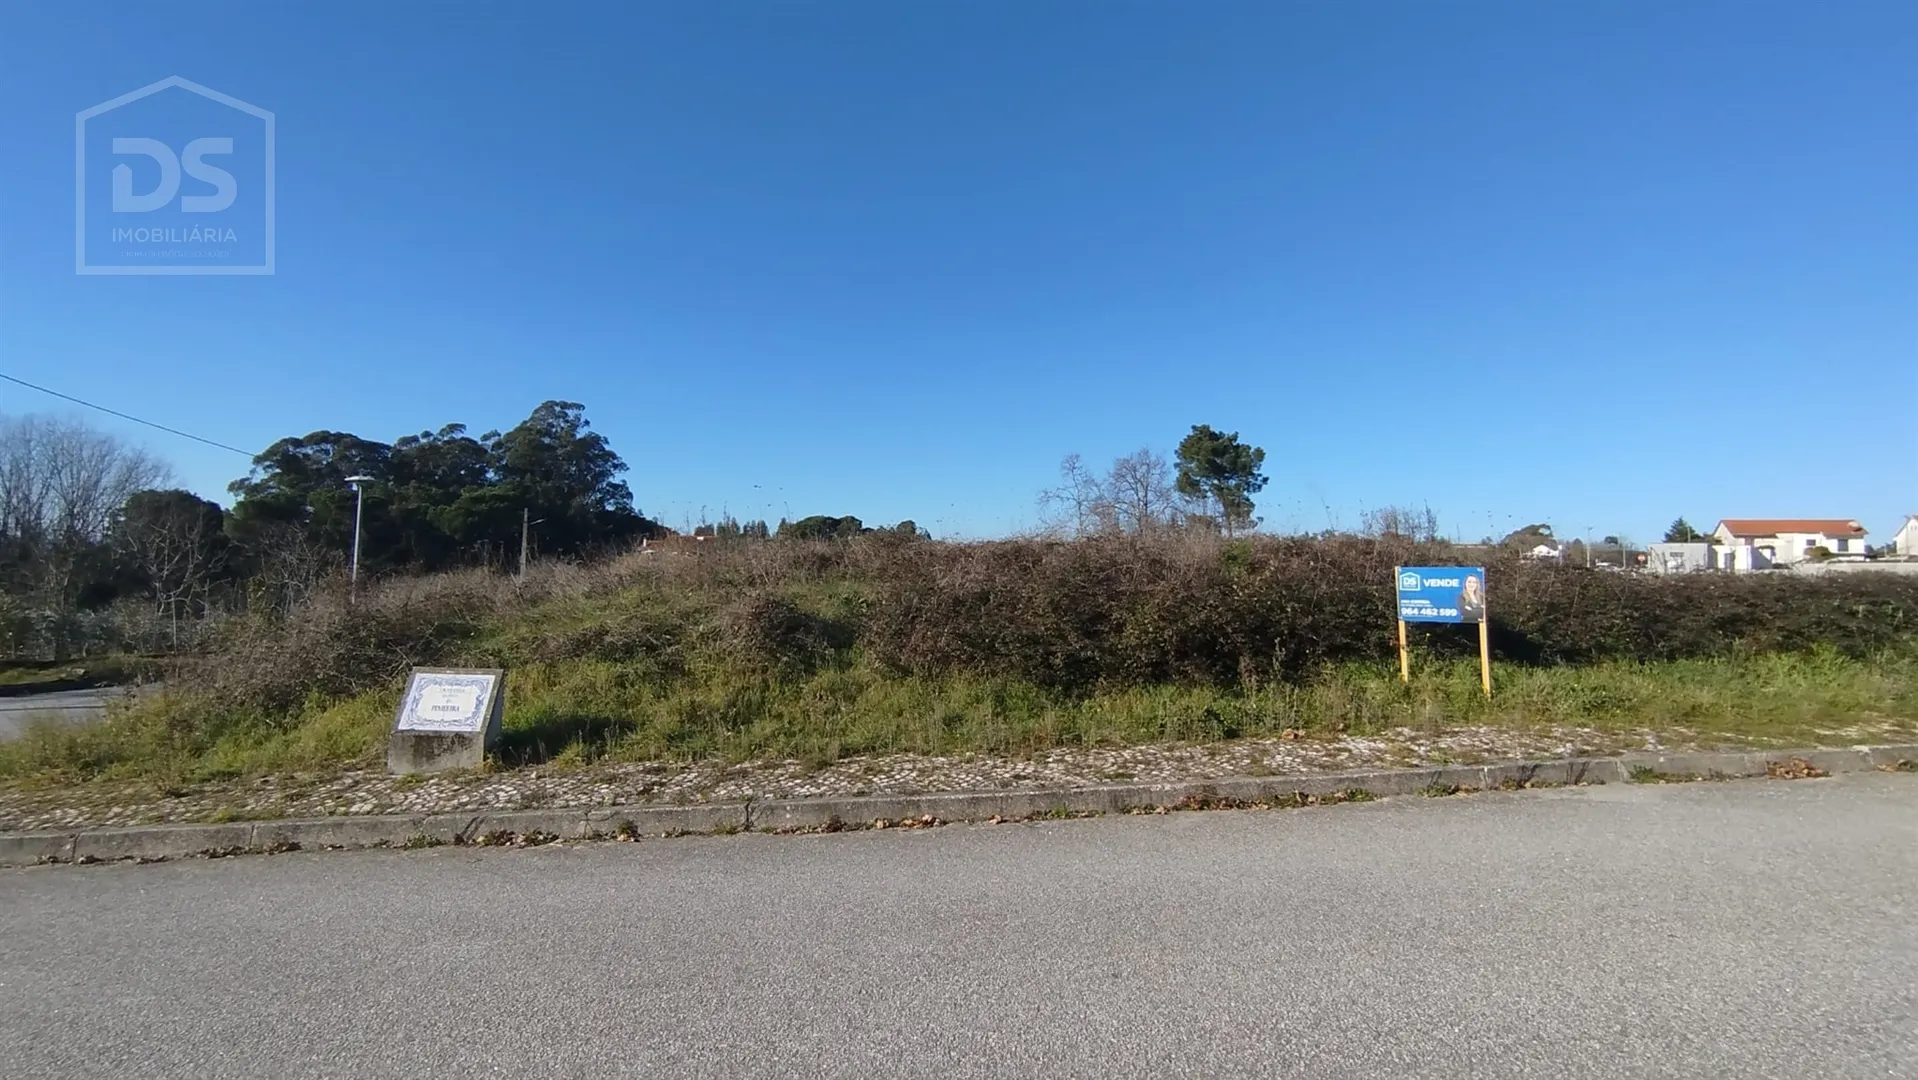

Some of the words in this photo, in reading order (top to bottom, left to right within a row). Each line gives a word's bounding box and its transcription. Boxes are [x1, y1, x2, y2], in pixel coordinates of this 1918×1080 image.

[1403, 576, 1417, 586] DS
[1423, 578, 1460, 588] VENDE
[1400, 607, 1419, 615] 964
[1439, 608, 1458, 617] 599
